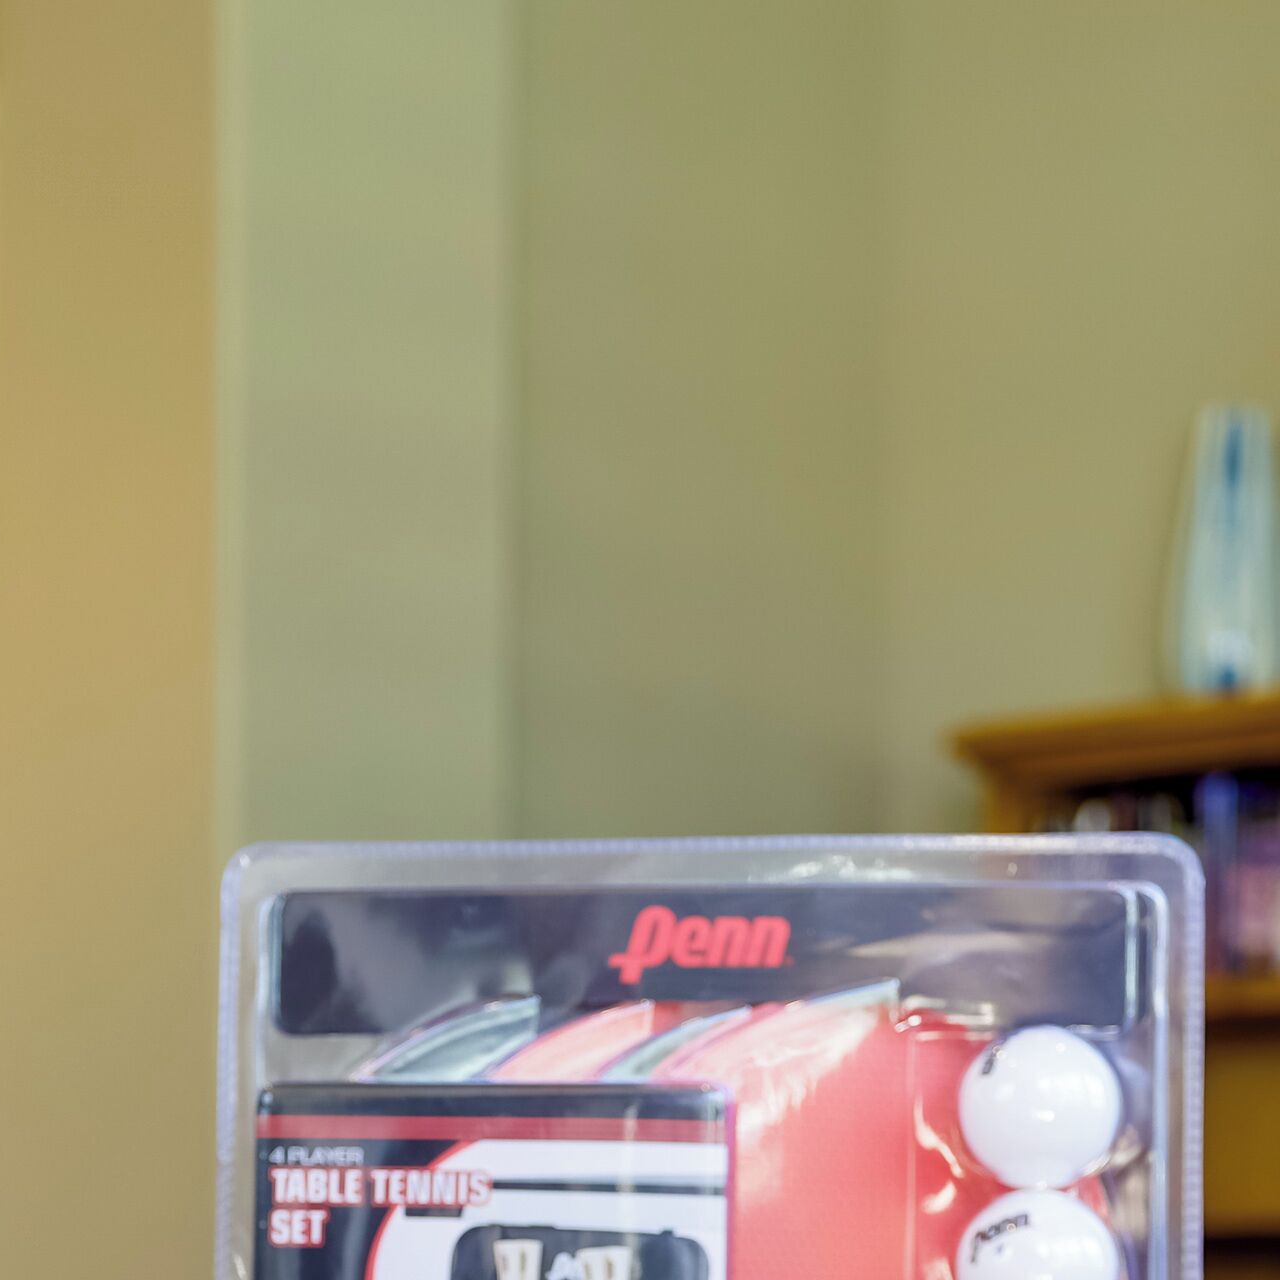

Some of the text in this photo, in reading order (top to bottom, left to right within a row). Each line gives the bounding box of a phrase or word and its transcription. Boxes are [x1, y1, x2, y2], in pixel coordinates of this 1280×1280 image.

[269, 1146, 364, 1166] 4 PLAYER
[270, 1167, 491, 1206] TABLE TENNIS
[270, 1208, 328, 1245] SET
